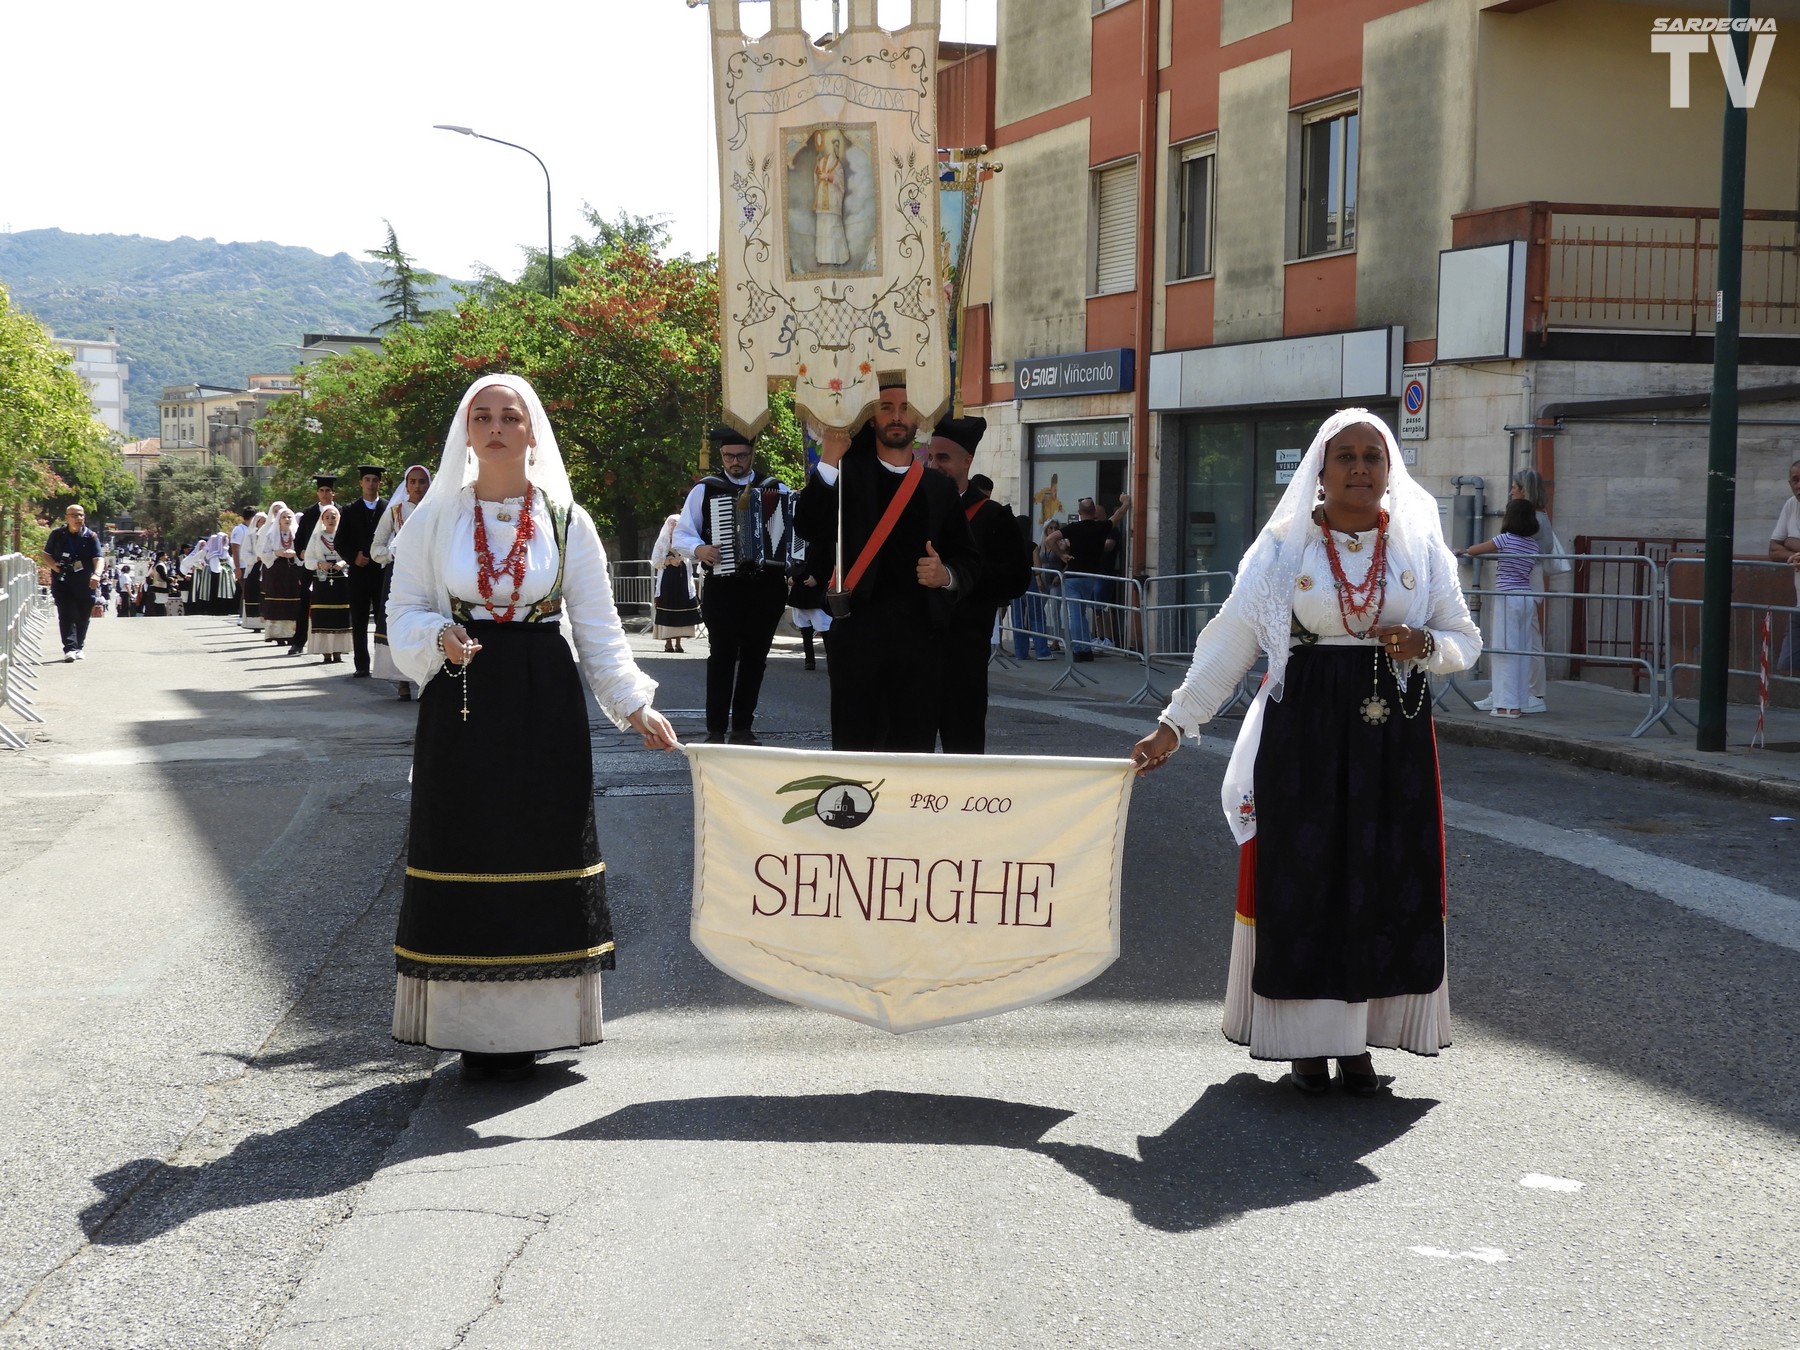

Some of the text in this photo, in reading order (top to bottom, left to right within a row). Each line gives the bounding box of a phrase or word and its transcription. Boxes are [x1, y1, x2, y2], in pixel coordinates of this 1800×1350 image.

[1063, 361, 1114, 385] Vincendo
[1036, 432, 1069, 449] SCOMMESSE
[1070, 431, 1099, 448] SPORTIVE
[1102, 430, 1119, 446] SLOT
[910, 792, 1013, 814] PRO LOCO
[752, 852, 1056, 929] SENEGHE
